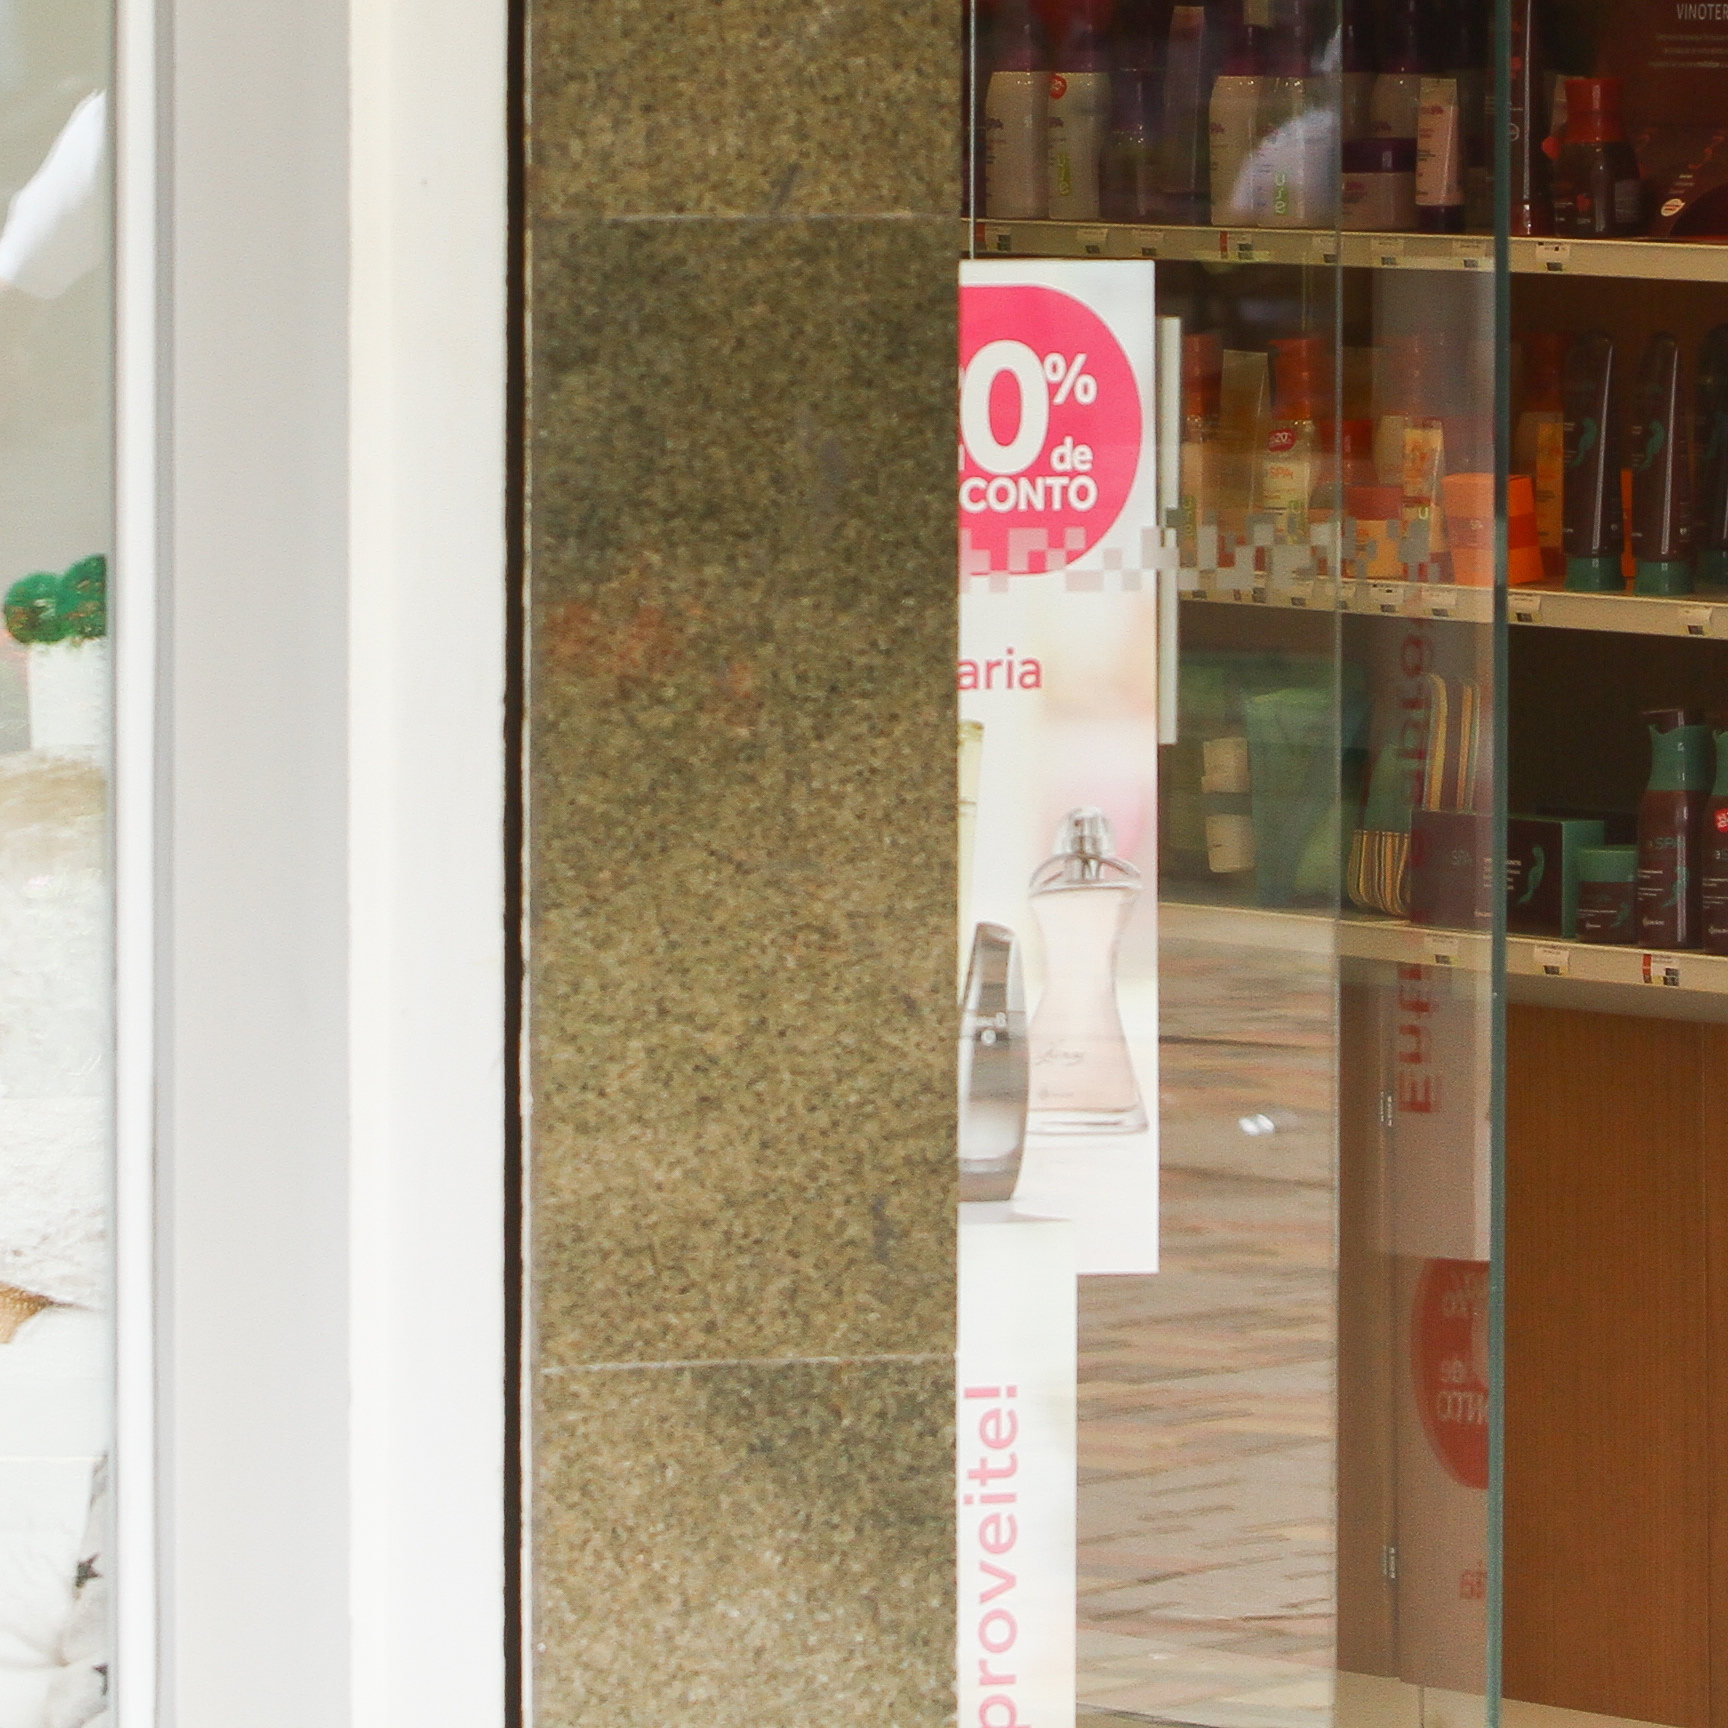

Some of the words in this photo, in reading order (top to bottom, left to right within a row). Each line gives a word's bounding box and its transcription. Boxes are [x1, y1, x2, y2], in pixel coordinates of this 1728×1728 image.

[1049, 435, 1094, 473] de
[959, 476, 1098, 513] CONTO
[958, 646, 1044, 692] aria
